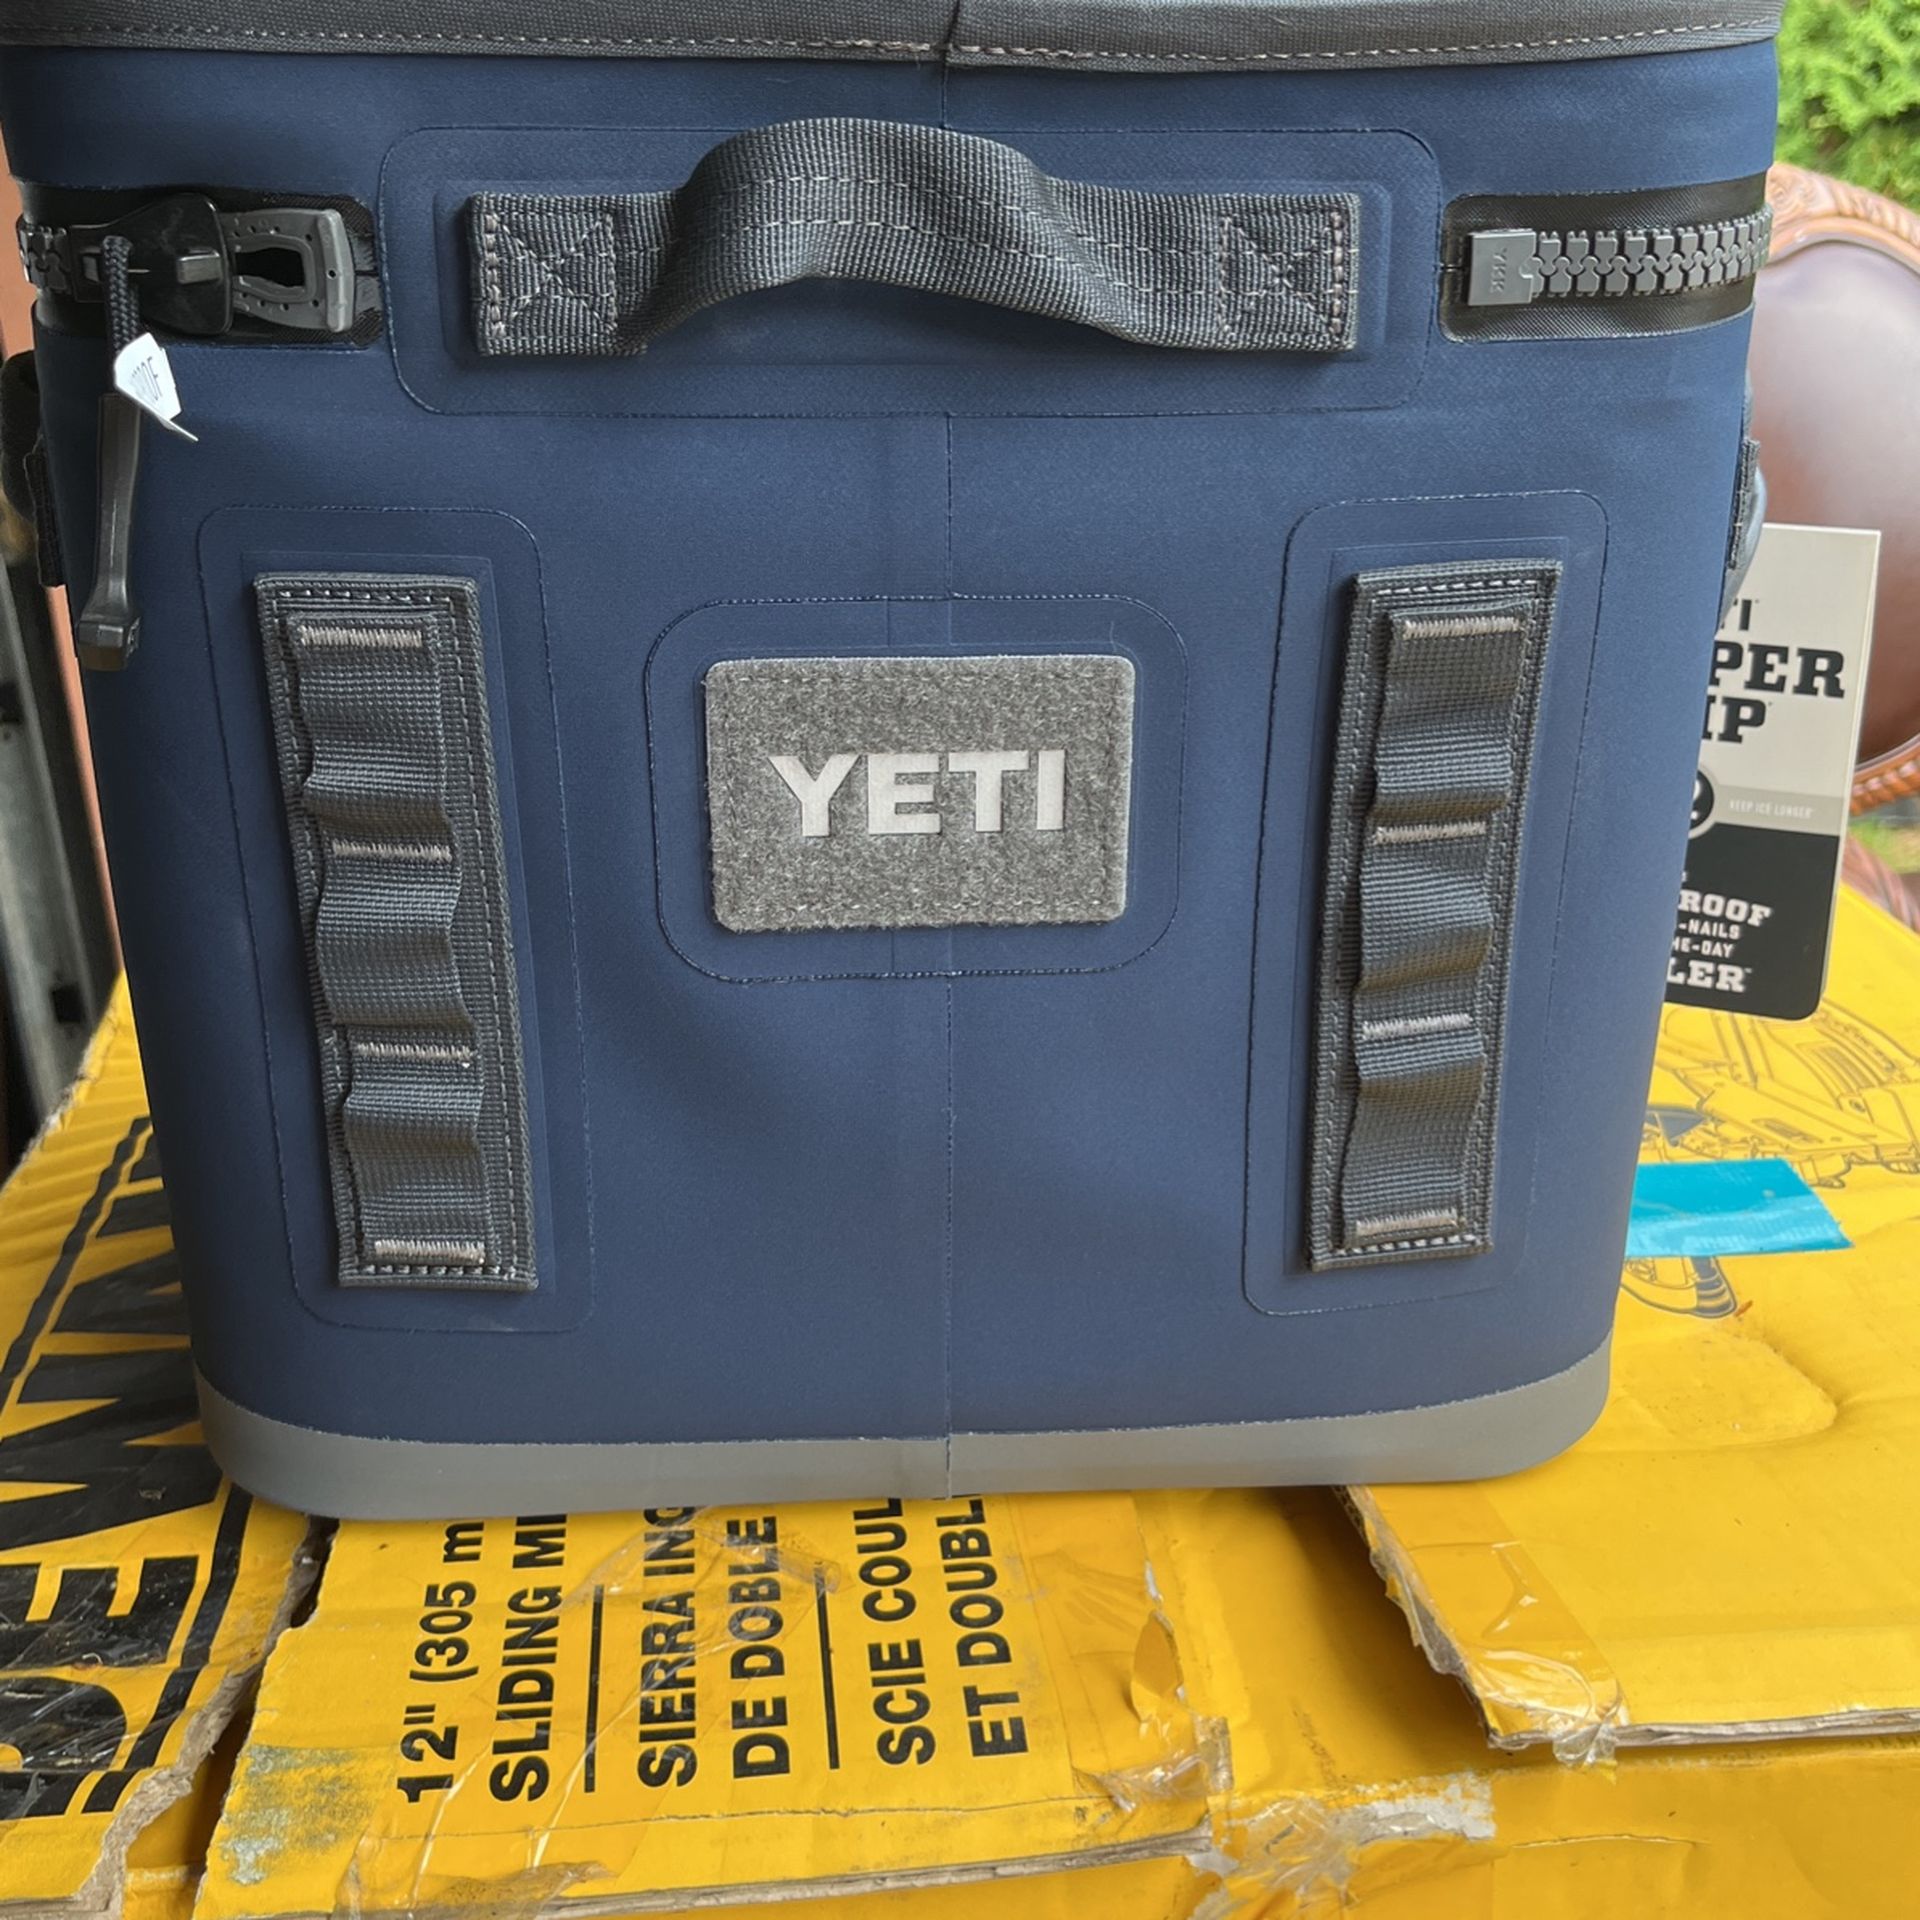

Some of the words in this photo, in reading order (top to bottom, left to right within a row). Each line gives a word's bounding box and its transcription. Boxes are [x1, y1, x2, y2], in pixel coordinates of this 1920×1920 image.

[768, 749, 1066, 838] YETI
[409, 1581, 479, 1682] (305
[728, 1516, 785, 1680] DOBLE
[935, 1493, 1012, 1667] DOUBL
[489, 1586, 562, 1802] SLIDING
[637, 1591, 697, 1787] SIERRA
[731, 1696, 790, 1779] DE
[867, 1638, 936, 1766] SCIE
[963, 1685, 1029, 1757] ET
[397, 1704, 459, 1803] 12"
